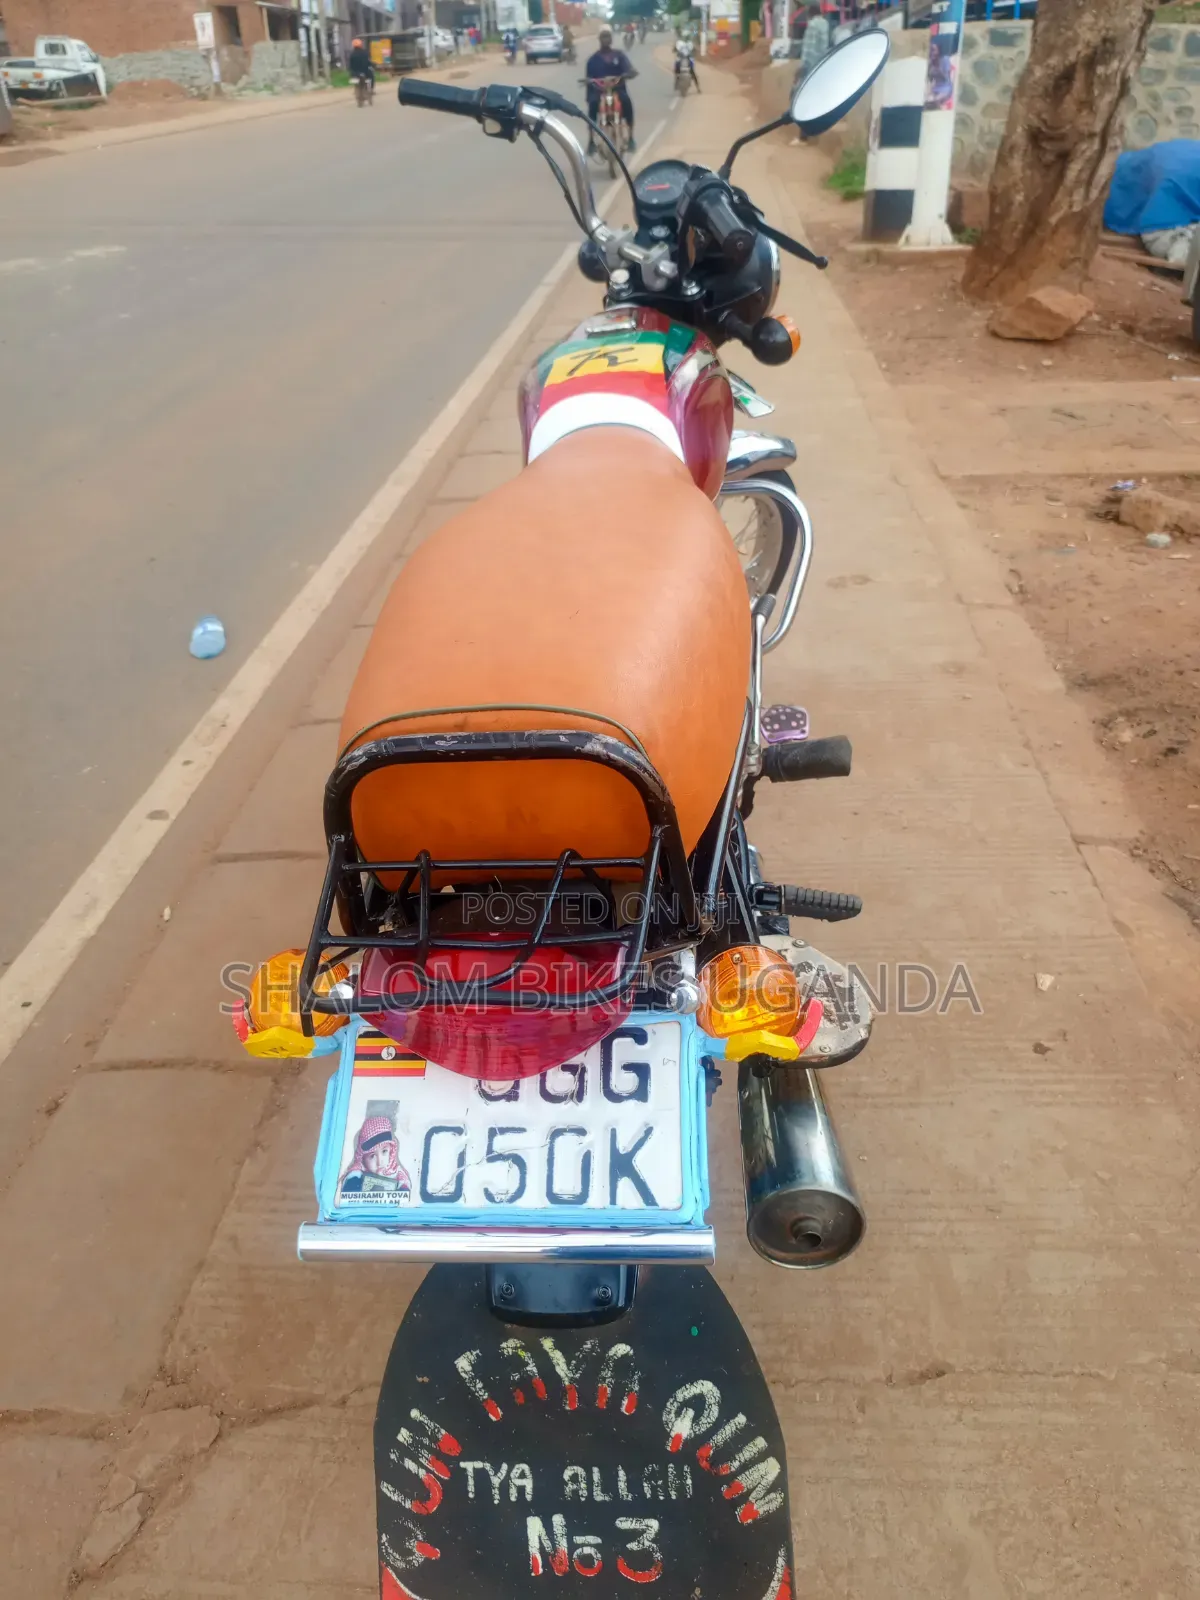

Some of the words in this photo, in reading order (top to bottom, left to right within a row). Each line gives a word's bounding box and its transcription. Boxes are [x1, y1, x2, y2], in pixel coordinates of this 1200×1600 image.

[477, 1026, 652, 1104] GG
[459, 1461, 534, 1504] TYA
[563, 1463, 693, 1501] ALLAH
